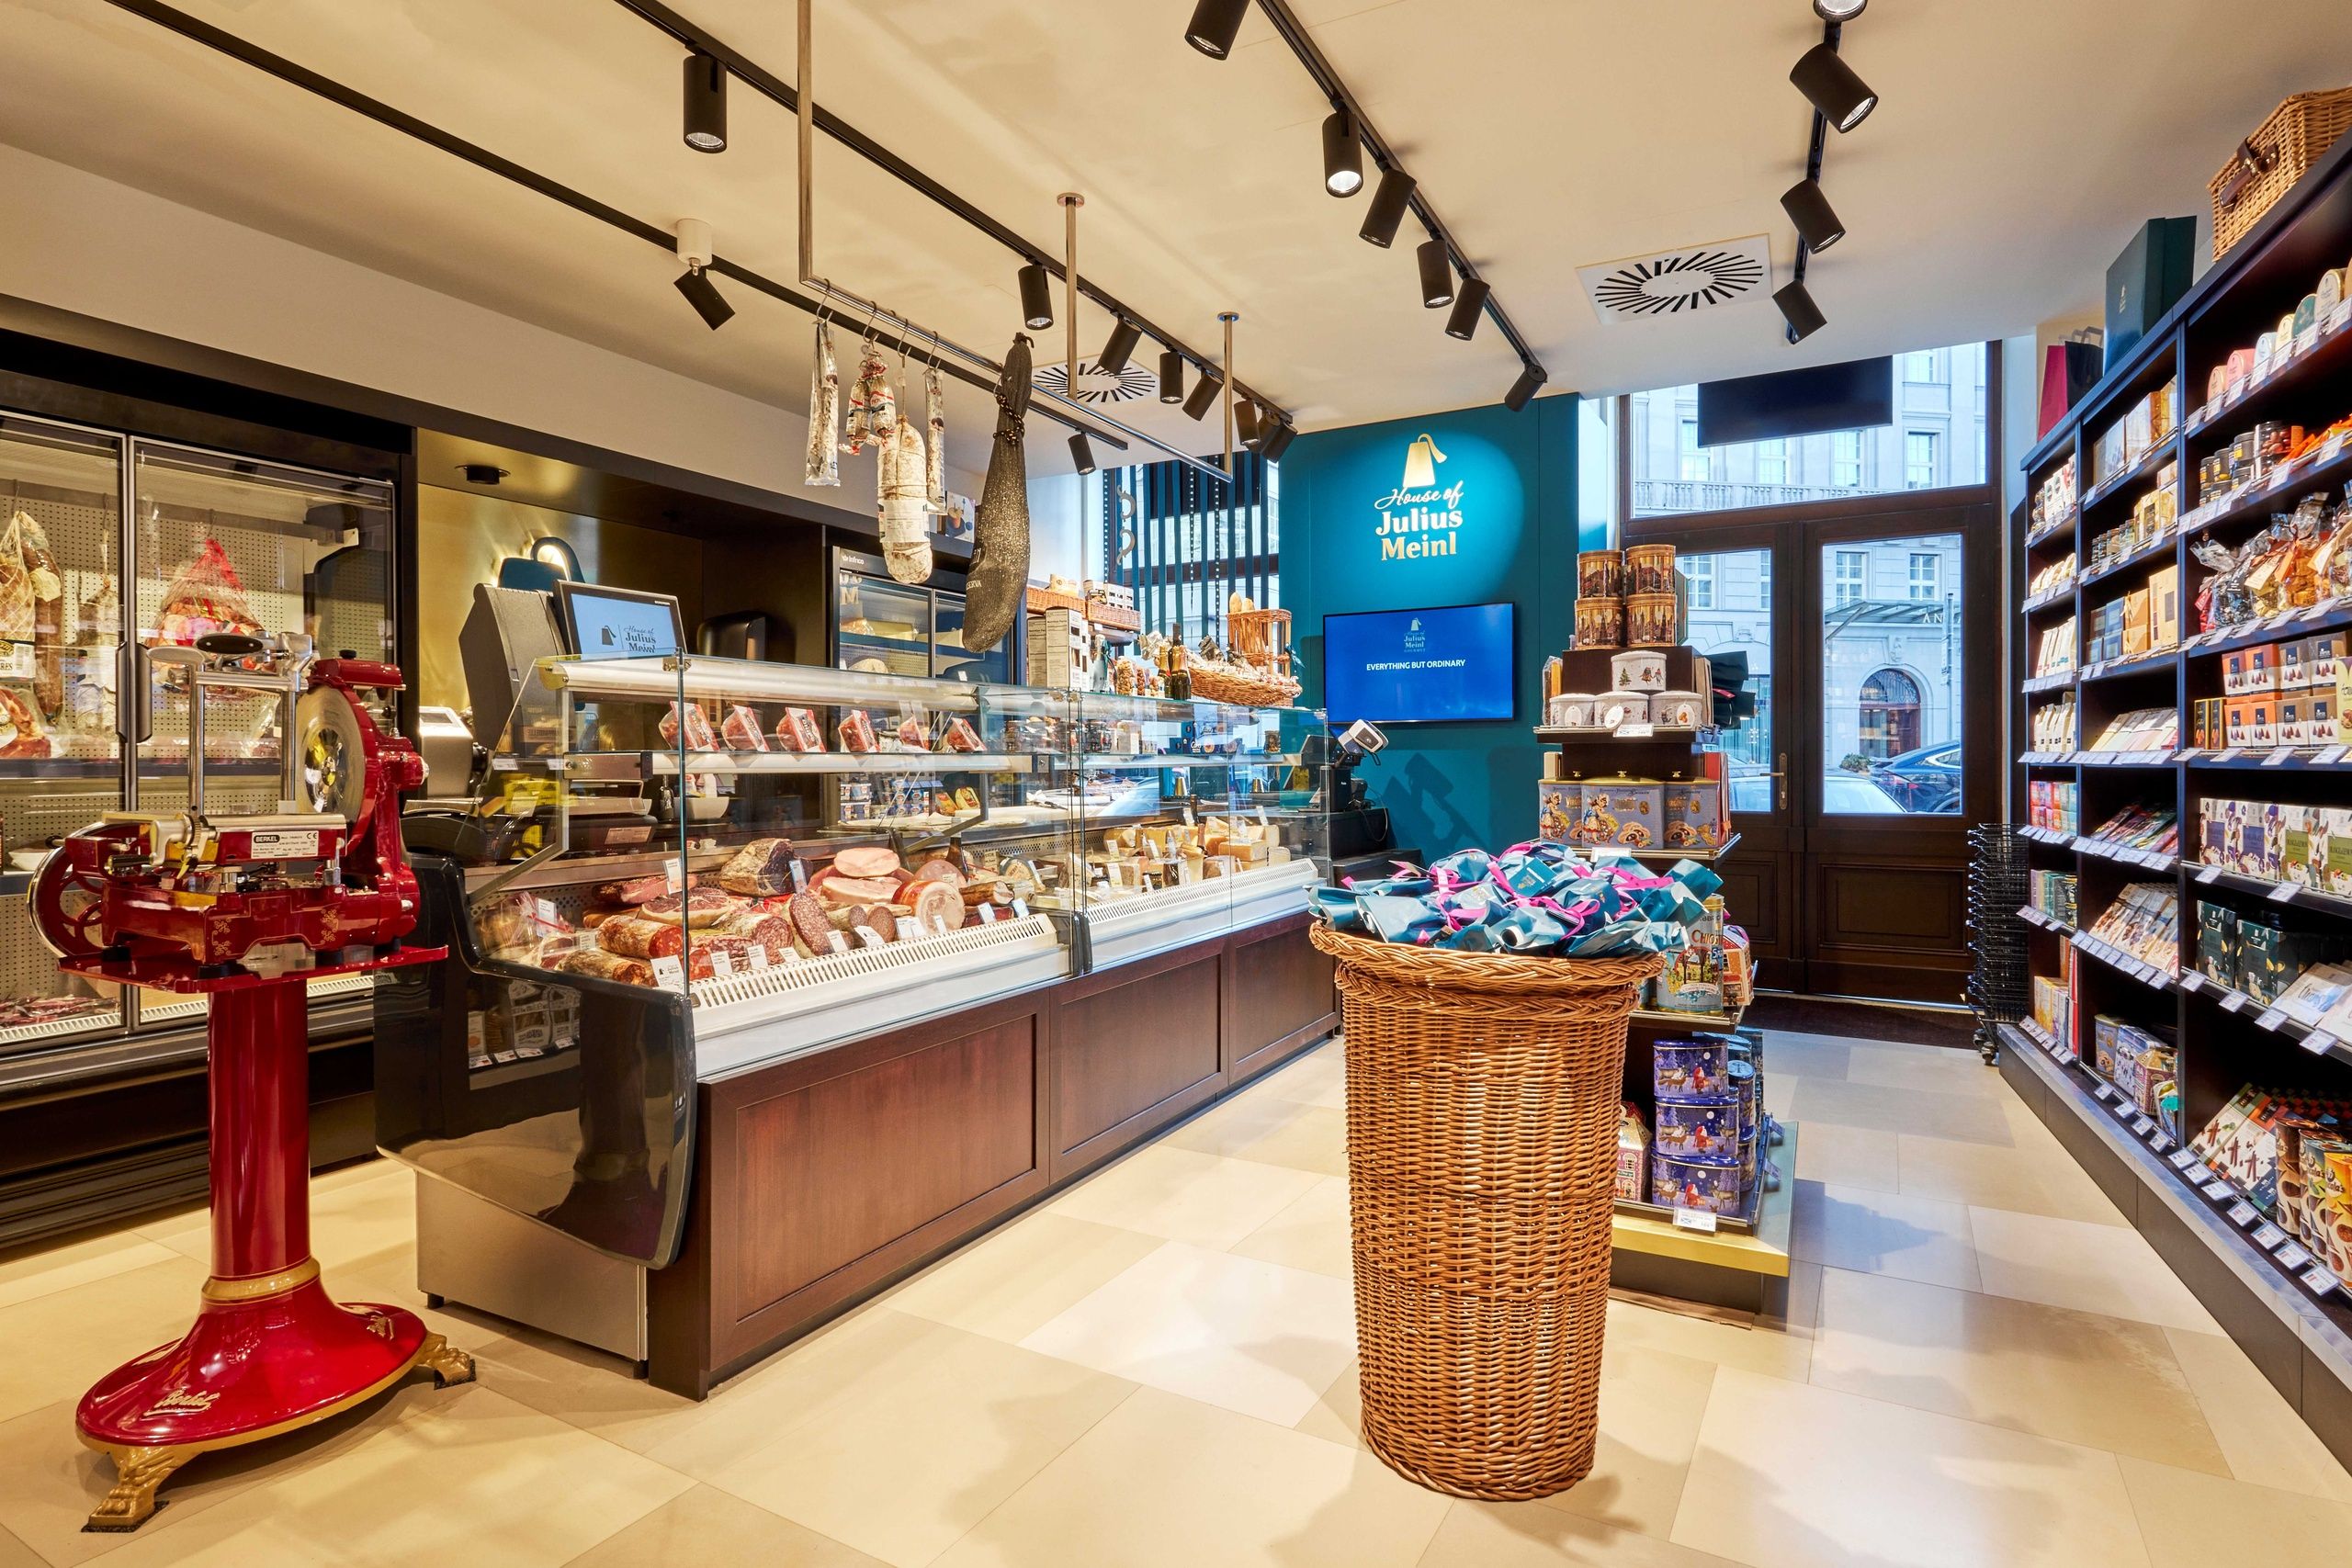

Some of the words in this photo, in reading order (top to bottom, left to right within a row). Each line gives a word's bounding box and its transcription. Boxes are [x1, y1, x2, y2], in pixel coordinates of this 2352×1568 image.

[1374, 487, 1442, 510] House
[1442, 479, 1464, 509] of
[1375, 506, 1463, 536] Julius
[1381, 531, 1457, 561] Meinl
[625, 632, 656, 644] Julius
[628, 642, 656, 653] Meinl
[1366, 661, 1410, 671] EVERYTHING
[1426, 660, 1466, 668] ORDINARY
